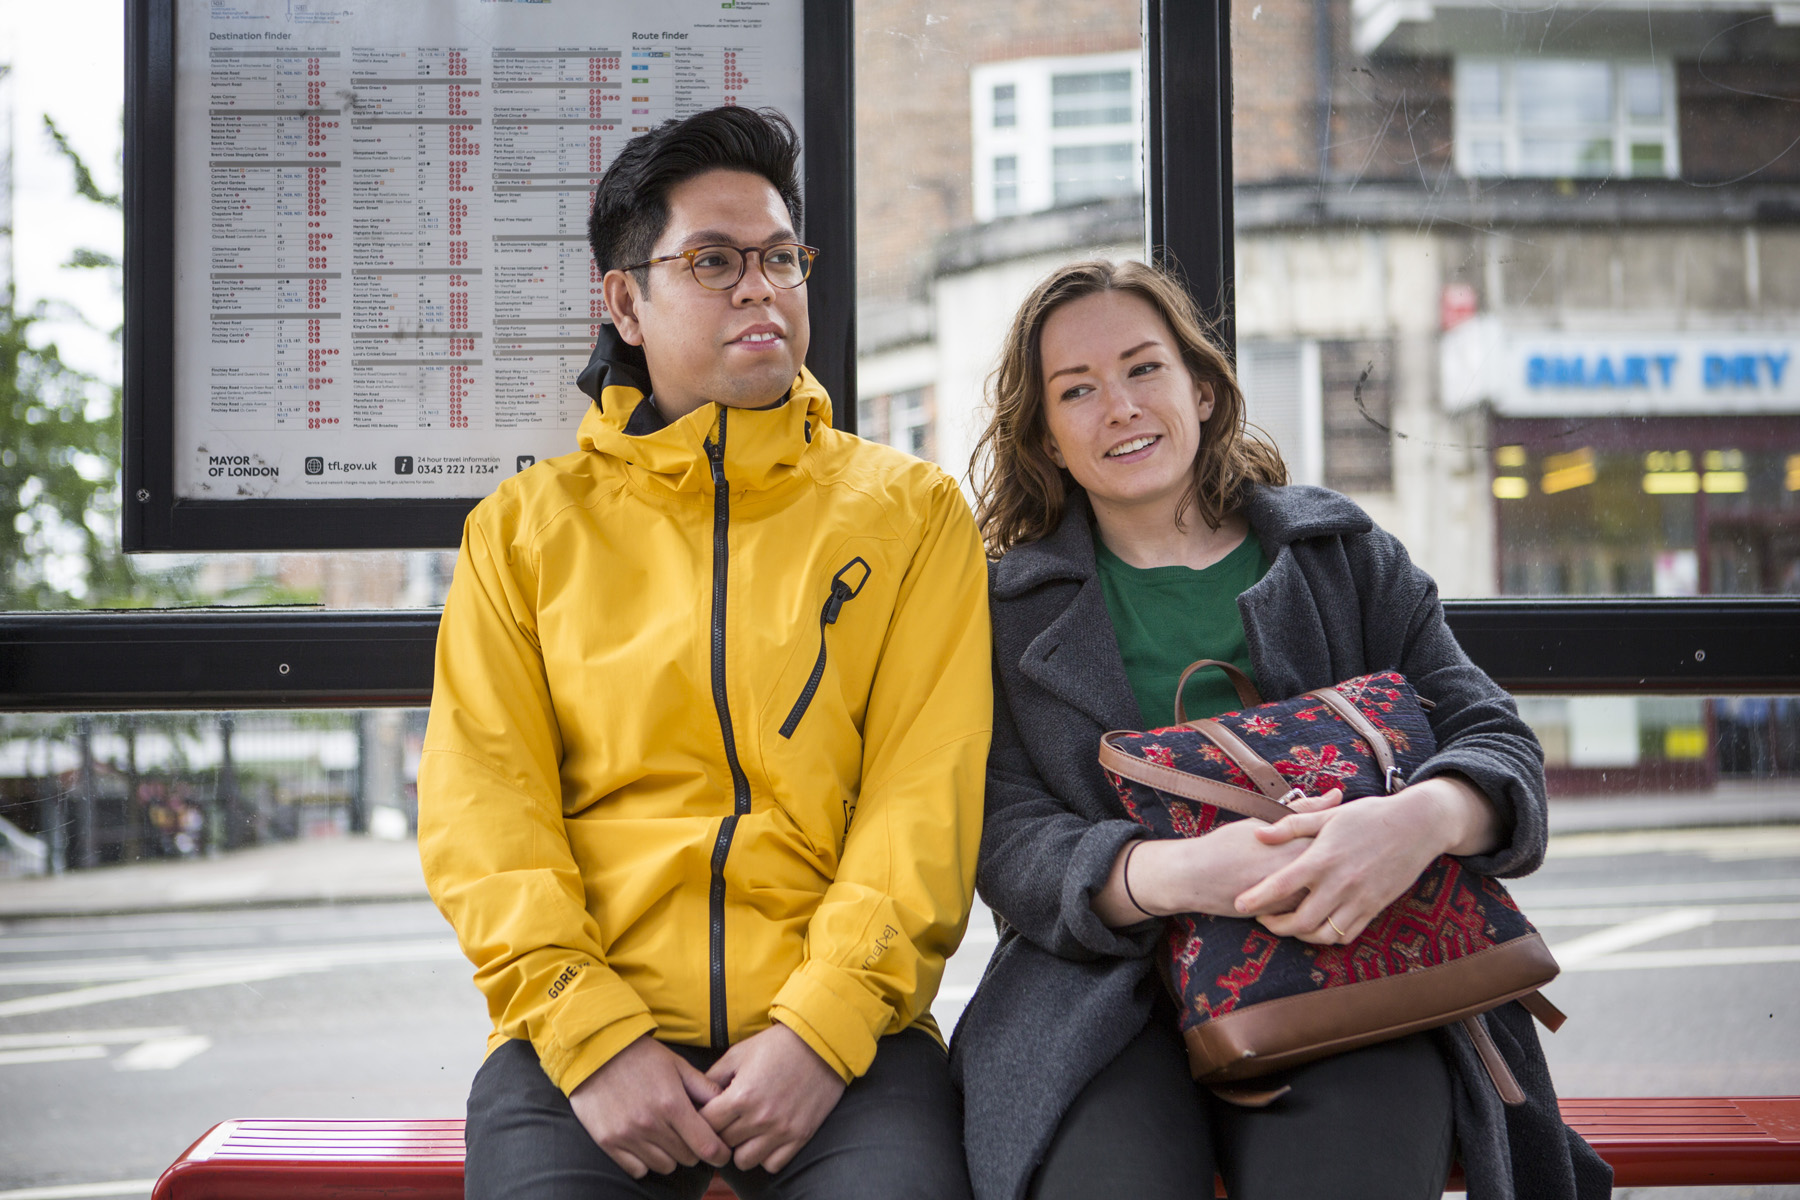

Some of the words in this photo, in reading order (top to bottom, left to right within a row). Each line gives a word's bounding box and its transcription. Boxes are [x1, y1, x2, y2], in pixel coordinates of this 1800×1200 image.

[1527, 354, 1677, 388] SMART
[1702, 352, 1790, 388] DRY
[209, 456, 250, 465] MAYOR
[328, 462, 377, 472] tfl.gov.uk
[418, 465, 443, 474] 0343
[447, 465, 464, 474] 222
[209, 468, 224, 476] OF
[228, 468, 279, 476] LONDON
